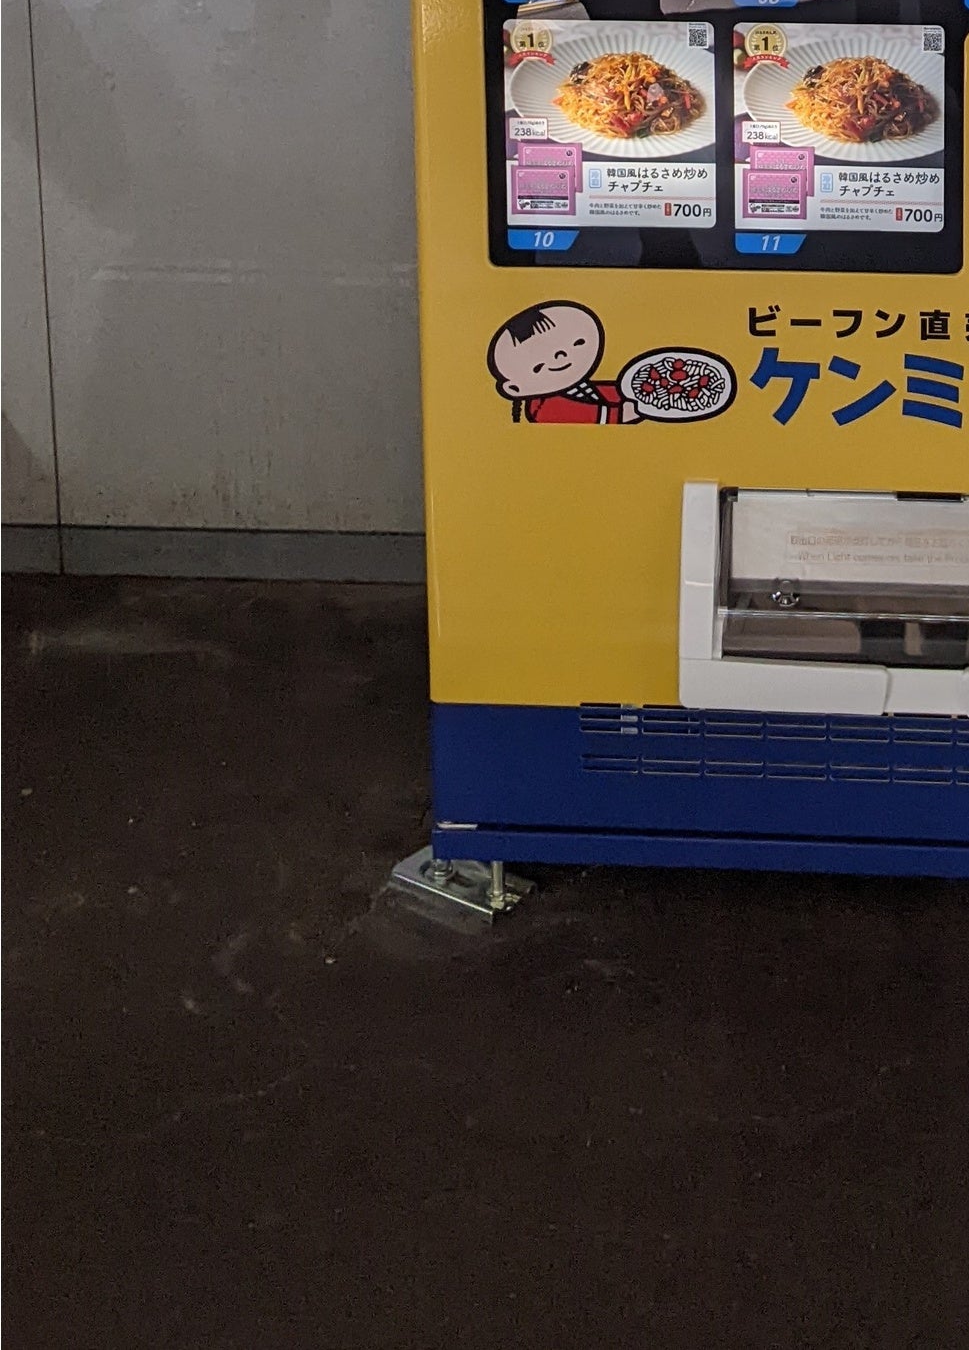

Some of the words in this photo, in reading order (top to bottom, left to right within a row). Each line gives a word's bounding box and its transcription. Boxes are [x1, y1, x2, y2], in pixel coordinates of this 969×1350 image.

[514, 128, 546, 136] 238kcal
[747, 131, 778, 140] 238kcal
[607, 168, 708, 179] 韓国風はるさめ炒め
[839, 171, 940, 184] 韓国風はるさめ炒め
[608, 181, 664, 193] チャプチェ
[839, 185, 895, 197] チャプチェ
[673, 203, 712, 217] 700円
[905, 209, 943, 222] 700円
[533, 231, 554, 248] 10
[762, 235, 781, 251] 11
